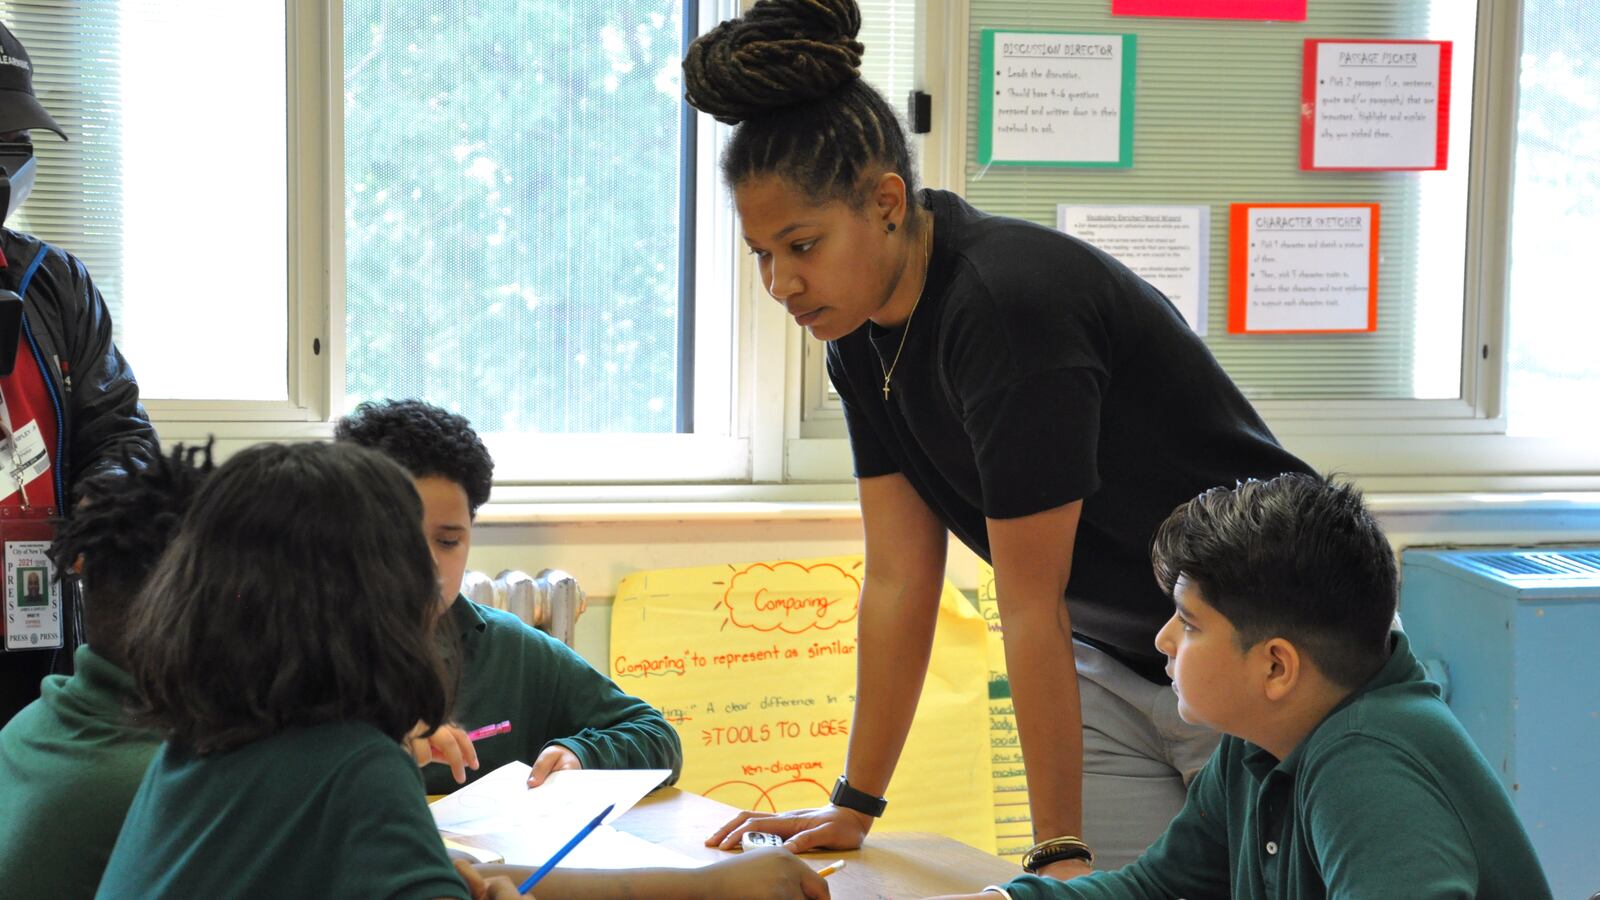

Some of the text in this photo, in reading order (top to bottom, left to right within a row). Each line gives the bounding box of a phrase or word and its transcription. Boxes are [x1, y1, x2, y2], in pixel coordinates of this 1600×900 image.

[1003, 43, 1114, 57] DISCUSSION DIRECTOR
[1340, 52, 1418, 64] PASSAGE PICKER
[1008, 67, 1028, 78] Leads
[1031, 68, 1042, 78] the
[1008, 87, 1031, 99] Should
[1032, 88, 1049, 99] have
[1068, 90, 1099, 102] questions
[998, 106, 1028, 118] prepared
[1031, 106, 1043, 116] and
[1046, 107, 1070, 117] written
[1073, 106, 1088, 116] down
[1101, 107, 1117, 117] their
[998, 123, 1028, 134] notebook
[1031, 124, 1039, 134] to
[1256, 217, 1363, 228] CHARACTER SKETCHER
[754, 587, 842, 618] Comparing
[9, 634, 28, 642] PRESS
[40, 632, 58, 640] PRESS
[713, 645, 780, 669] represent
[785, 648, 799, 660] as
[725, 702, 751, 714] clear
[760, 696, 816, 710] difference
[712, 719, 839, 747] TOOLS TO USE
